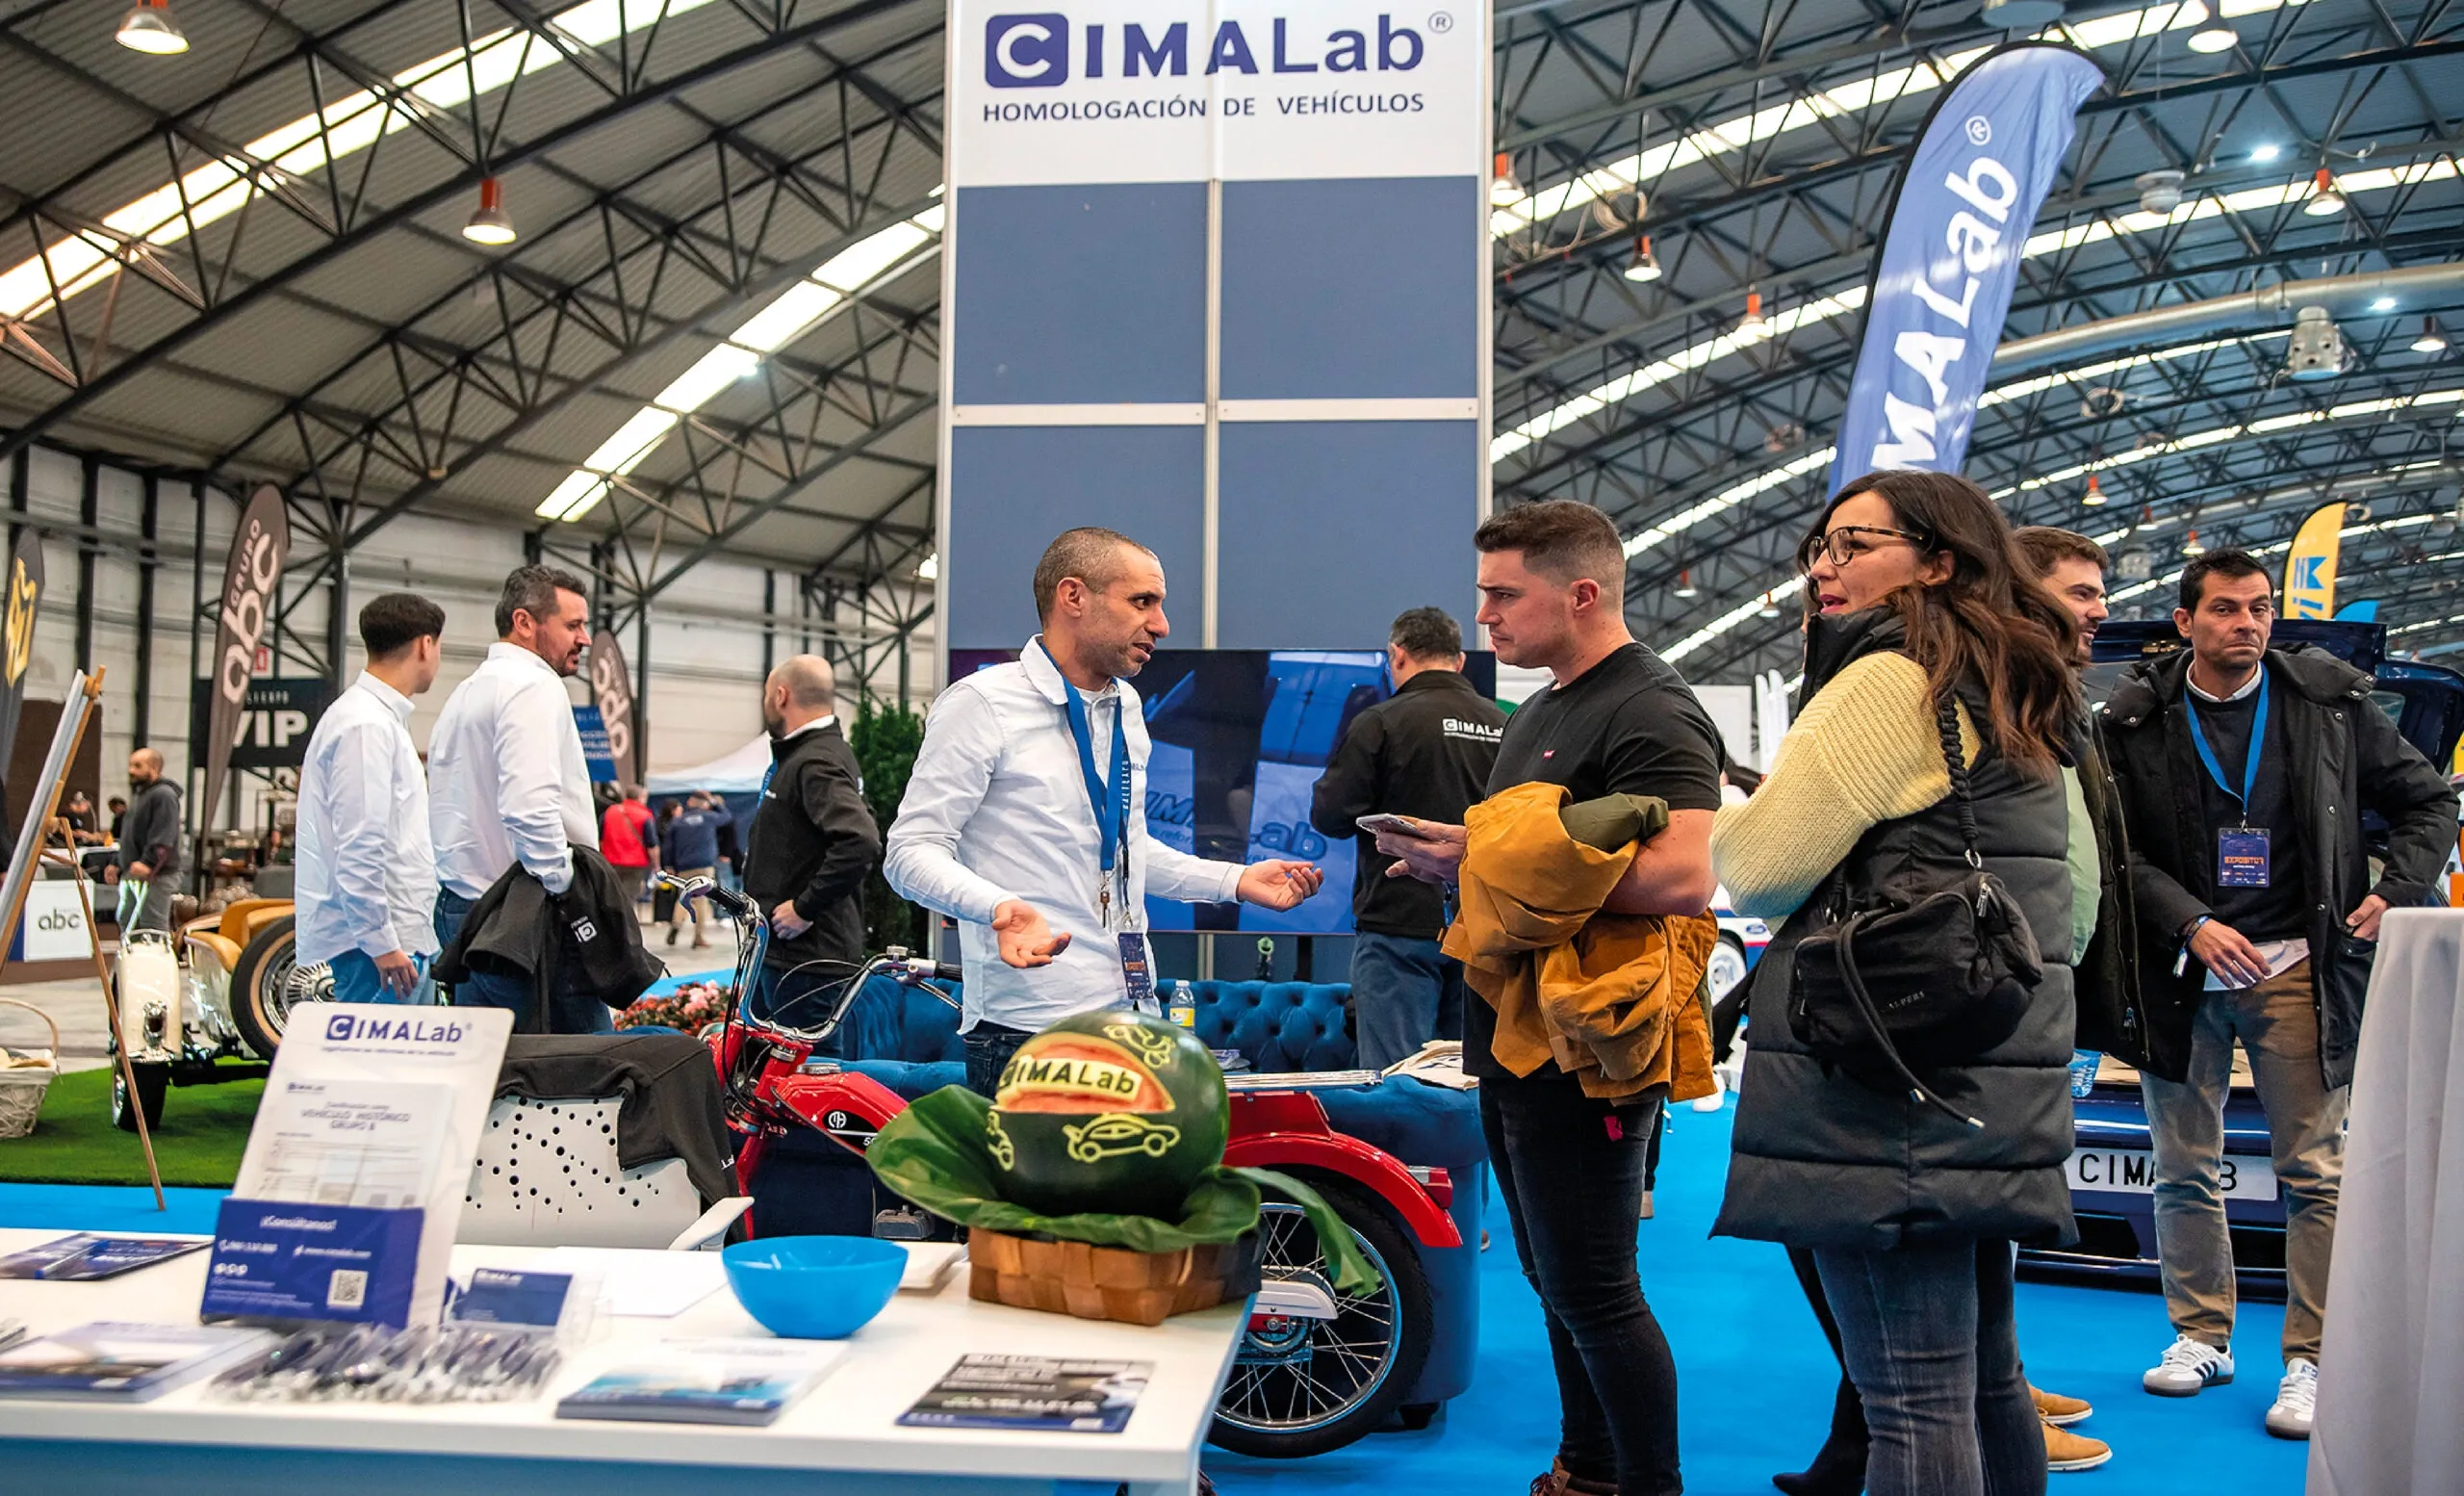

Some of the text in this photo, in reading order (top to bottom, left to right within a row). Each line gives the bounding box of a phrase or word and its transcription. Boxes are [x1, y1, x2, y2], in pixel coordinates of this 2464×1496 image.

[983, 90, 1425, 122] HOMOLOGACIÓN DE VEHÍCULOS
[229, 518, 262, 608] GRUPO
[222, 531, 279, 705] abc
[38, 907, 81, 931] abc
[2079, 1153, 2237, 1192] CIMB
